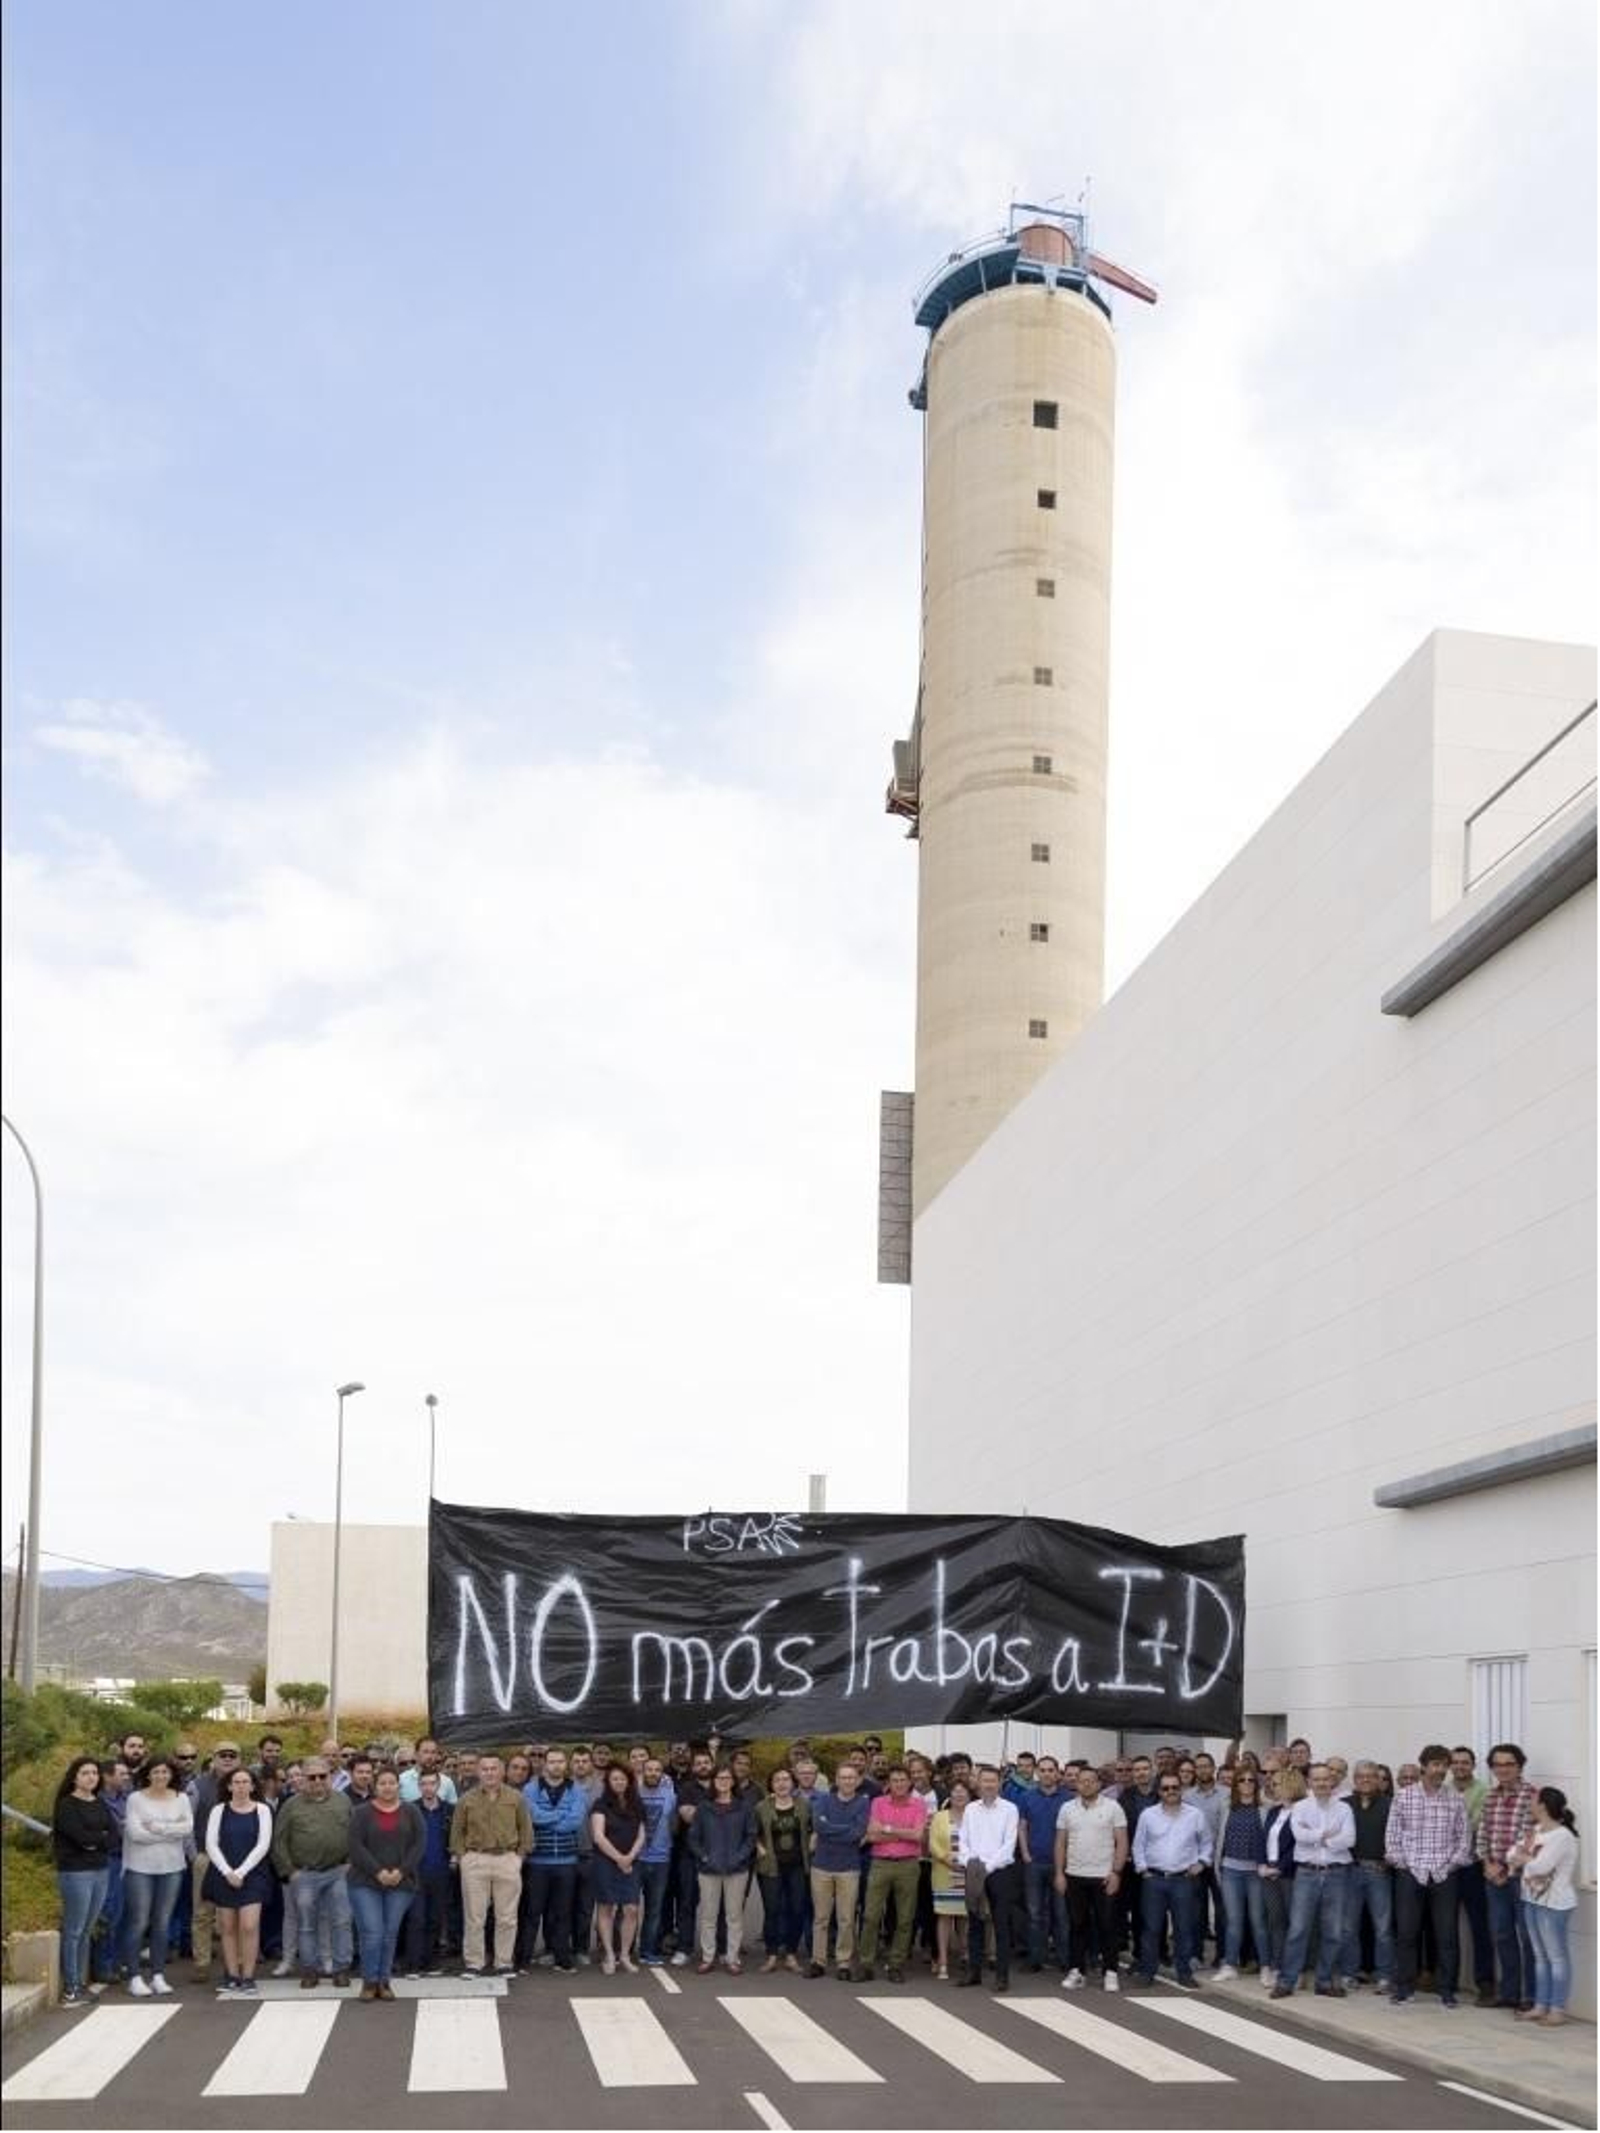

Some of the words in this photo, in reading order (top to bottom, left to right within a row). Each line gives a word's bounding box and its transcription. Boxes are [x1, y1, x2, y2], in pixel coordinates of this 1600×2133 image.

[683, 1516, 764, 1553] PSA
[453, 1571, 599, 1717] NO
[631, 1598, 816, 1703] más
[822, 1557, 1033, 1698] trabas
[1050, 1636, 1090, 1694] a
[1097, 1564, 1235, 1700] I+D
